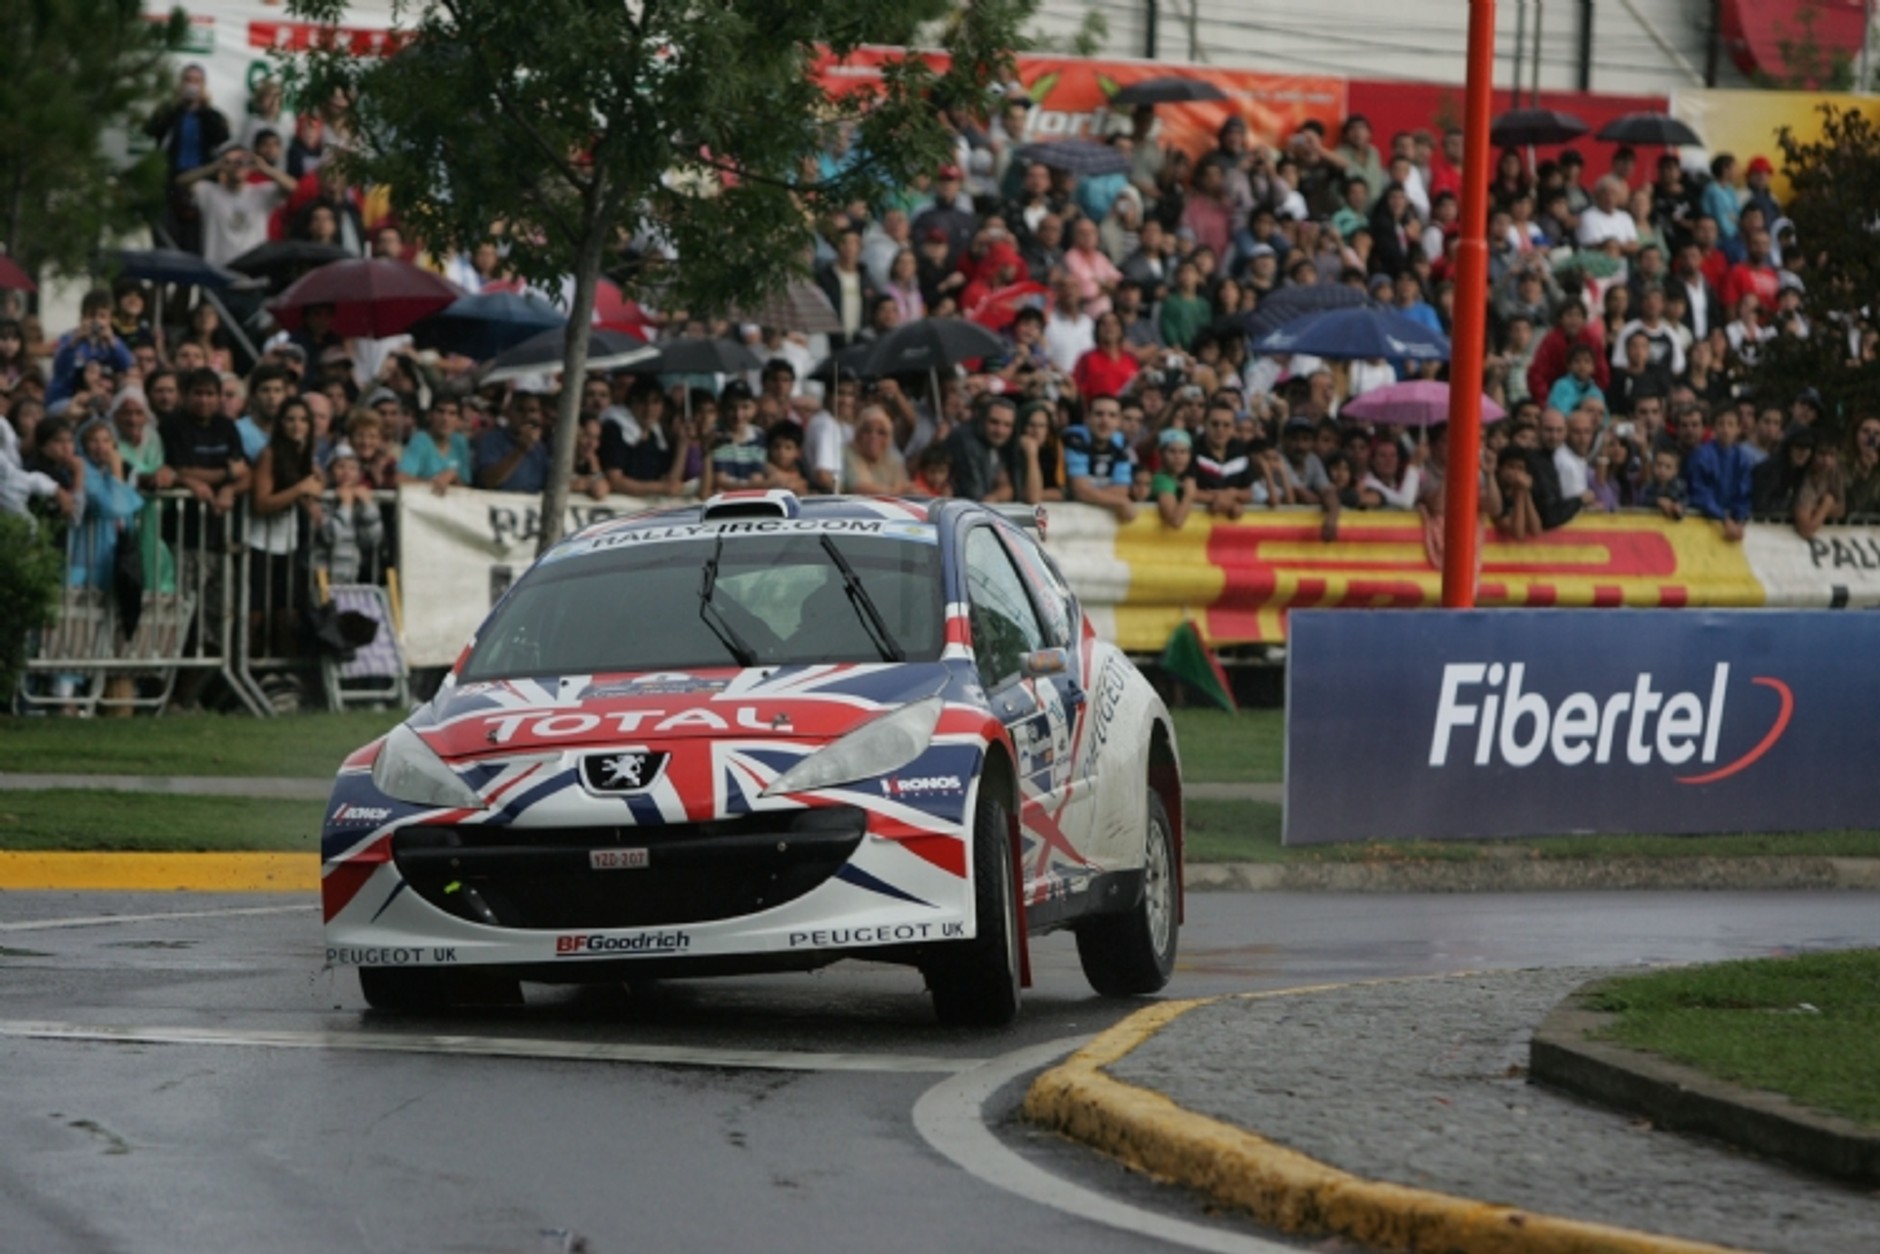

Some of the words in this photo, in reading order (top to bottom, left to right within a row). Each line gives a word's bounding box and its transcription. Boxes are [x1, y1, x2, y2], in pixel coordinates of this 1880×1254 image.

[484, 706, 794, 742] TOTAL
[1428, 662, 1730, 767] Fibertel
[880, 774, 961, 794] KRONOS
[556, 931, 690, 953] BFGoodrich
[789, 923, 932, 947] PEUGEOT
[942, 919, 964, 937] UK
[326, 947, 424, 965] PEUGEOT
[433, 946, 457, 962] UK
